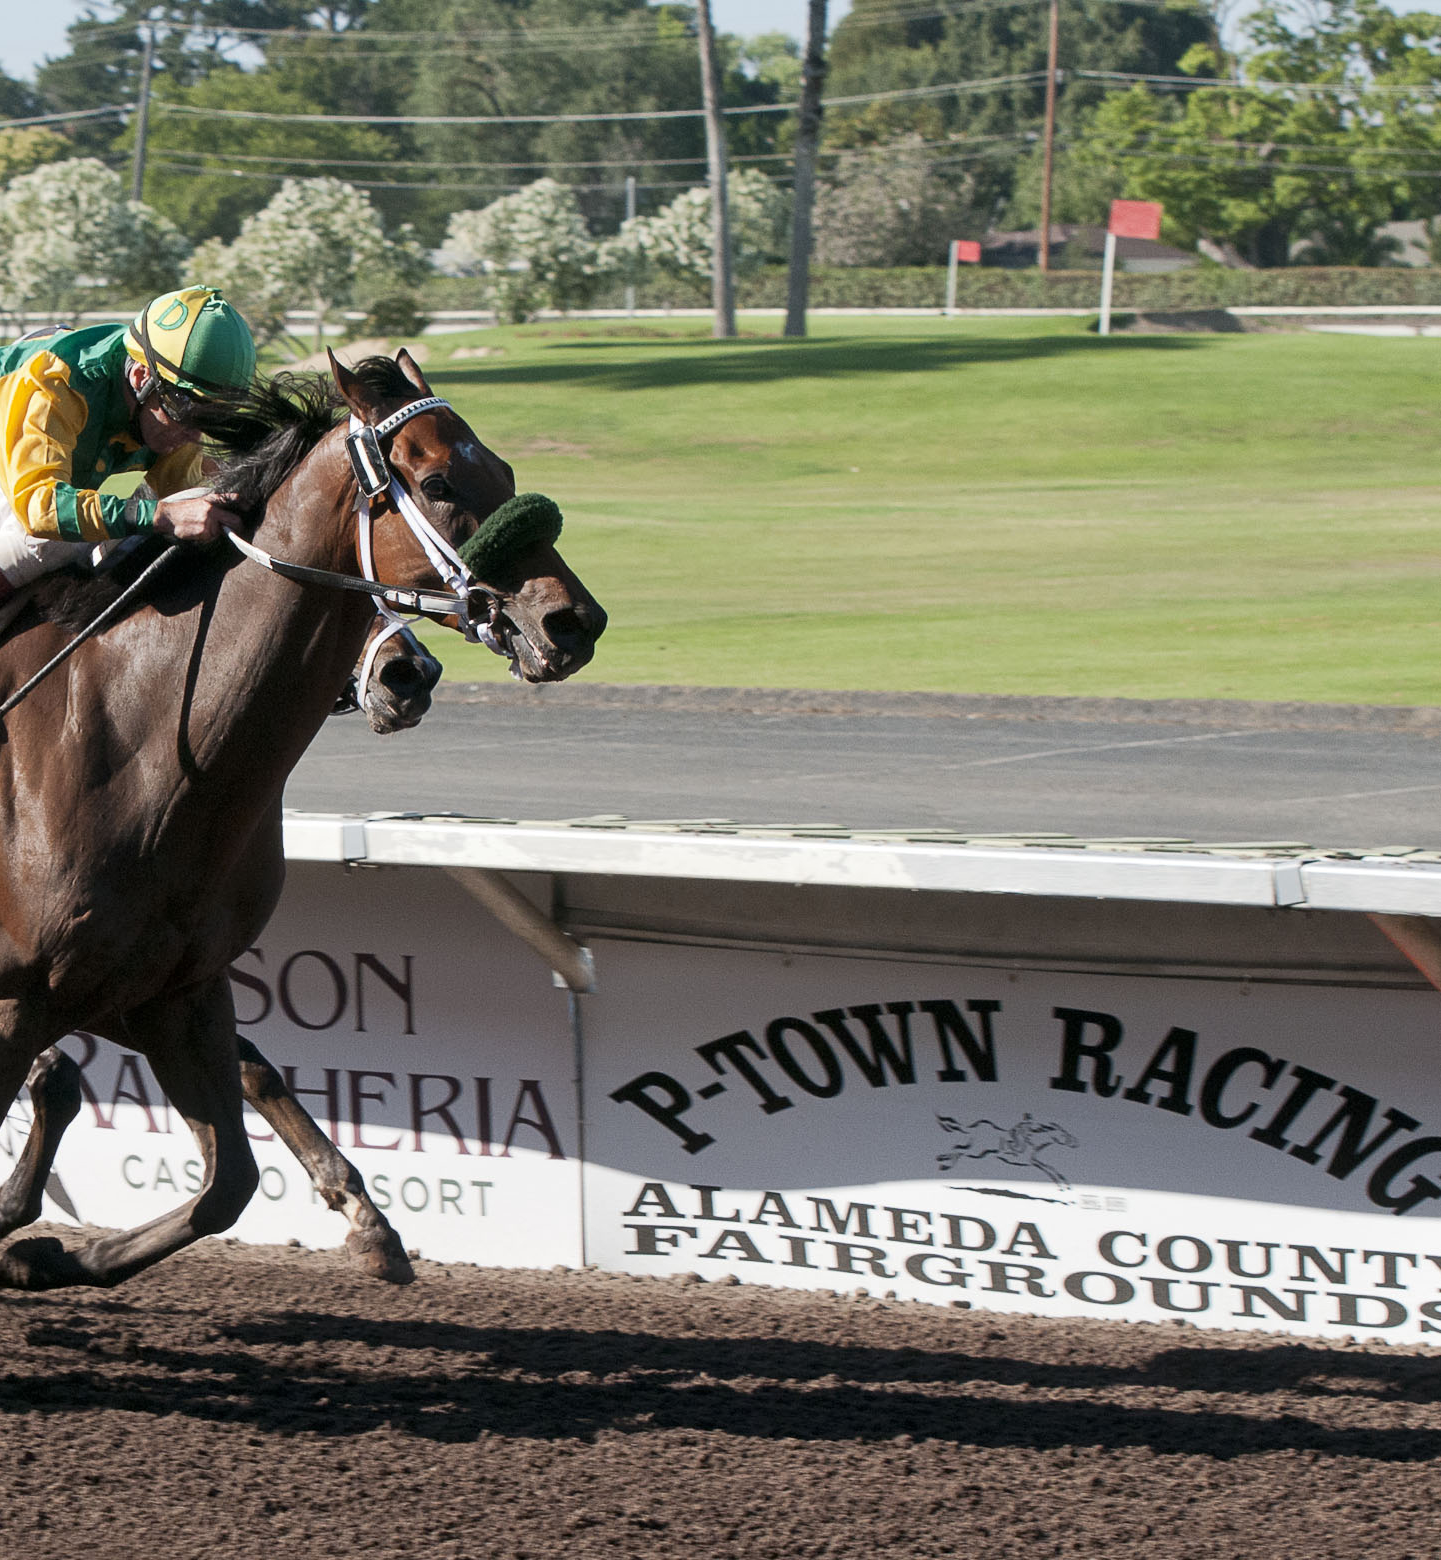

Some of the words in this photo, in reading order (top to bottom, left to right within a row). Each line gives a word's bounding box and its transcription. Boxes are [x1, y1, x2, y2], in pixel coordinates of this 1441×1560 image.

[154, 298, 189, 331] D
[609, 1000, 1001, 1155] P-TOWN
[1049, 1006, 1441, 1216] RACING
[122, 1154, 286, 1201] CASO
[311, 1174, 493, 1217] SORT
[622, 1182, 1059, 1260] ALAMEDA
